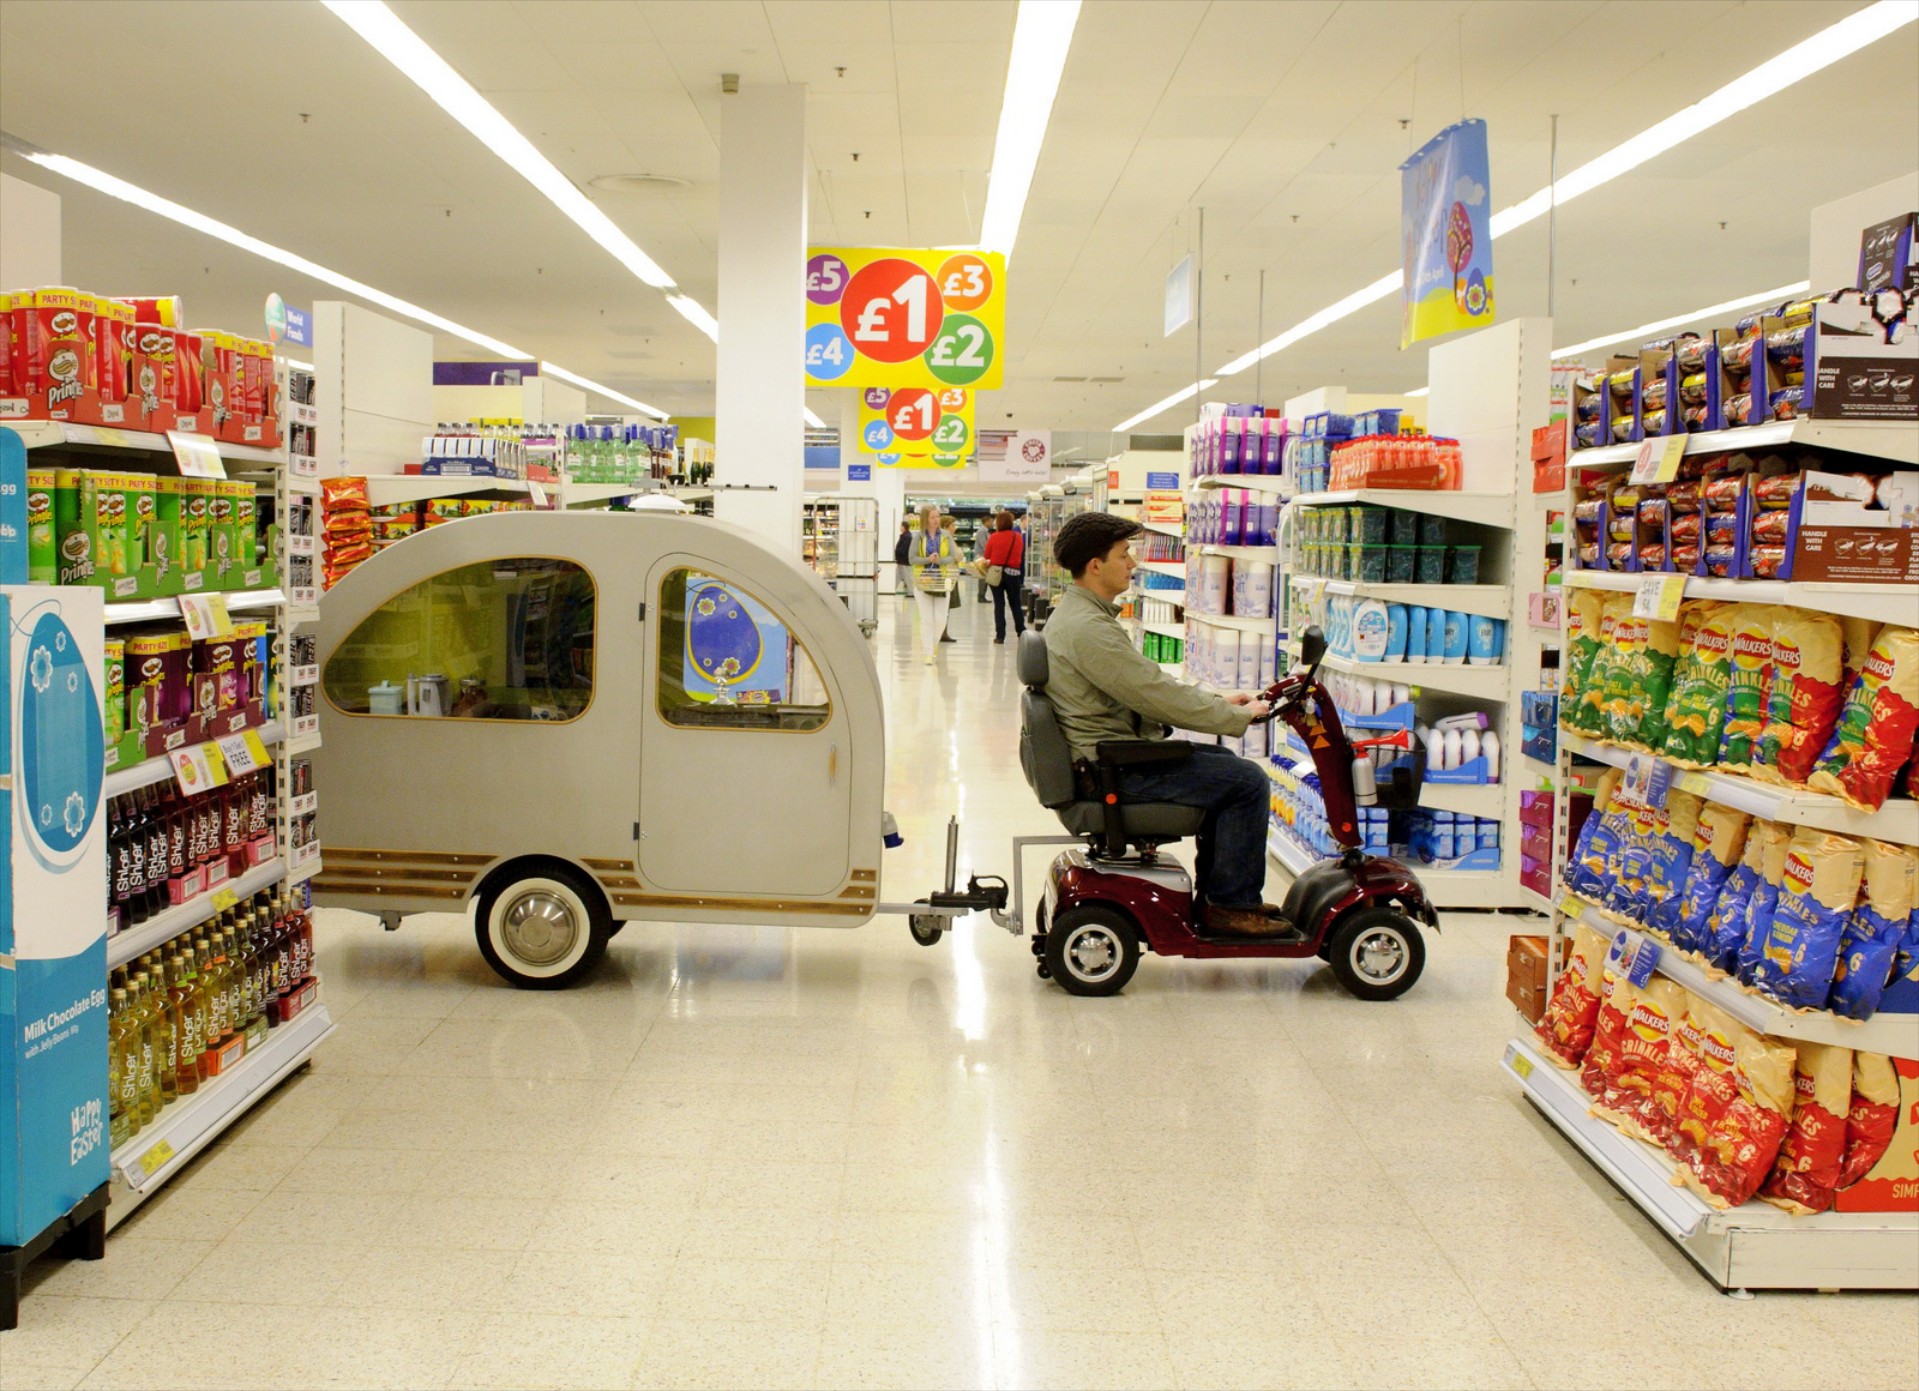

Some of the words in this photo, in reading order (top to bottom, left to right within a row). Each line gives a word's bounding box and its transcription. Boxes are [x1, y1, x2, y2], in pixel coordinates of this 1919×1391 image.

[807, 260, 842, 292] £5
[943, 264, 985, 297] £3
[42, 295, 71, 304] PARTY
[854, 274, 927, 343] £1
[806, 336, 844, 366] £4
[930, 324, 986, 368] £2
[893, 393, 933, 431] £1
[940, 388, 964, 406] £3
[867, 426, 889, 443] £4
[934, 420, 965, 444] £2
[1, 483, 17, 495] gg
[1694, 632, 1728, 650] WALKERS
[1734, 637, 1772, 654] WALKERS
[230, 751, 251, 767] FREE
[227, 807, 240, 845] Shloer
[257, 792, 267, 829] Shloer
[171, 825, 183, 866] Shloer
[196, 814, 208, 855] Shloer
[209, 810, 219, 850] Shloer
[117, 848, 129, 893] Shloer
[130, 843, 143, 890] Shloer
[1784, 858, 1815, 883] WALKERS
[278, 951, 289, 987] Shloer
[290, 943, 301, 978] Shloer
[1794, 943, 1807, 963] 6
[1850, 952, 1864, 972] 6
[24, 1018, 47, 1043] Milk
[47, 998, 90, 1031] Chocolate
[90, 988, 105, 1008] Egg
[208, 996, 219, 1038] Shloer
[1632, 1007, 1670, 1032] WALKERS
[181, 1016, 193, 1058] Shloer
[1621, 1039, 1665, 1067] CRINKLE
[1702, 1036, 1735, 1063] WALKERS
[122, 1053, 137, 1098] Shloer
[140, 1043, 152, 1088] Shloer
[1796, 1076, 1816, 1094] KERS
[71, 1098, 102, 1137] Happy
[71, 1122, 104, 1167] Easter
